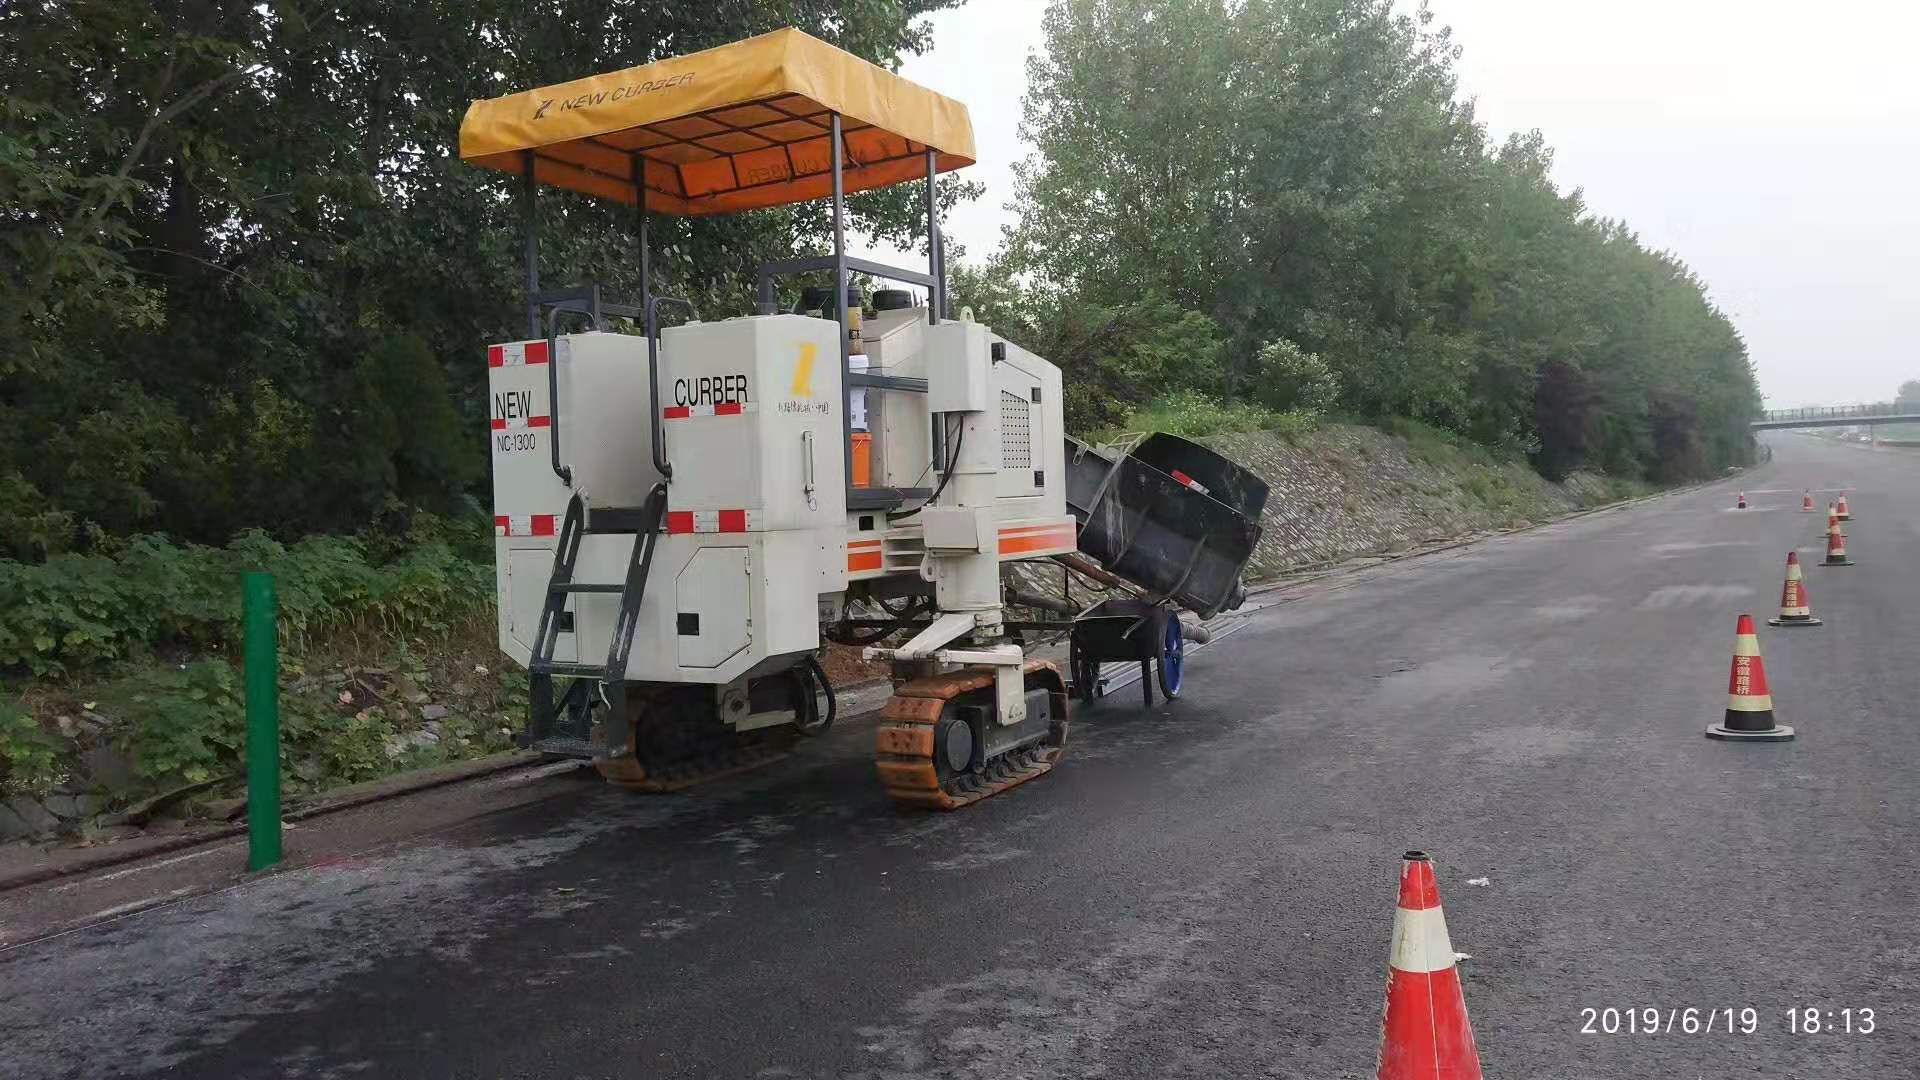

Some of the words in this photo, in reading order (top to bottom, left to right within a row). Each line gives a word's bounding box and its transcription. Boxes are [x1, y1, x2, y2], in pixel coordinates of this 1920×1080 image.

[560, 91, 609, 112] NEW
[611, 72, 696, 102] CURBER
[495, 390, 532, 420] NEW
[674, 374, 749, 408] CURBER
[497, 433, 536, 453] NC-1300
